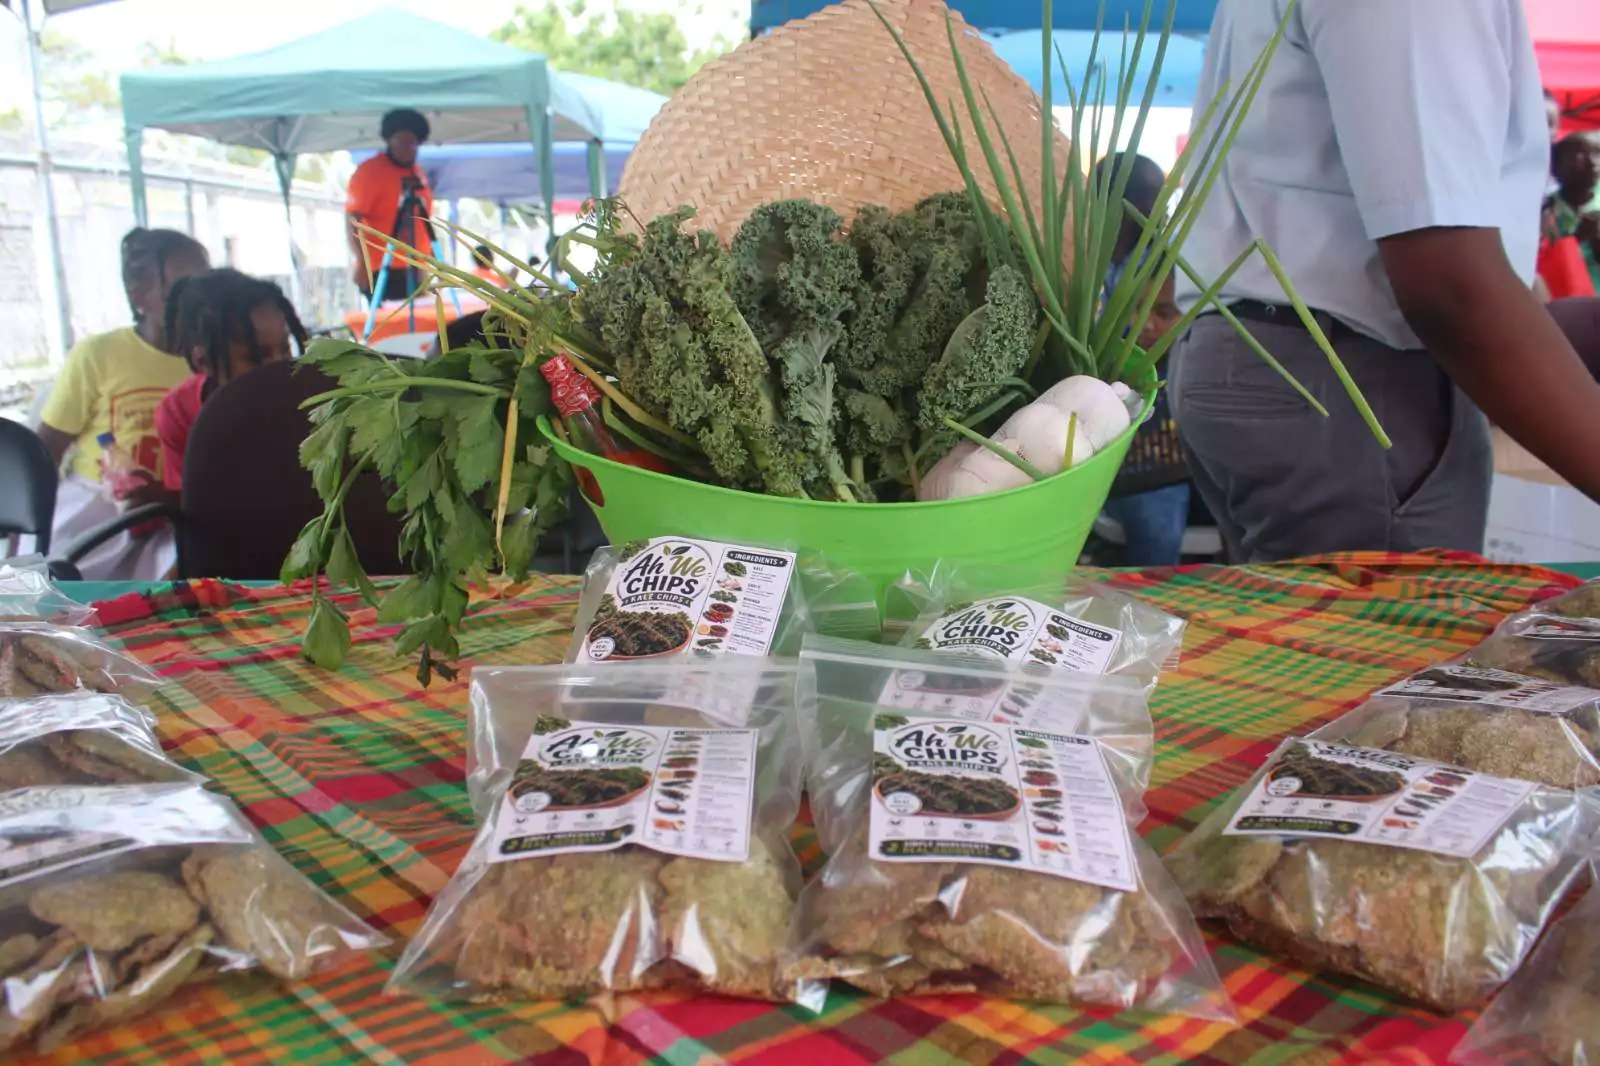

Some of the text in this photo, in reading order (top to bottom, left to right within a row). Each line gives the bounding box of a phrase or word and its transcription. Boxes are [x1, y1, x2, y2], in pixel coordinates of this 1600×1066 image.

[623, 553, 706, 583] Ah We
[734, 553, 778, 566] INGREDIENTS
[626, 575, 699, 595] CHIPS
[630, 592, 683, 603] KALE CHIPS
[941, 609, 1029, 632] Ah We
[1058, 618, 1104, 639] INGREDIENTS
[944, 624, 1020, 645] CHIPS
[895, 730, 999, 750] Ah We
[903, 748, 999, 765] CHIPS
